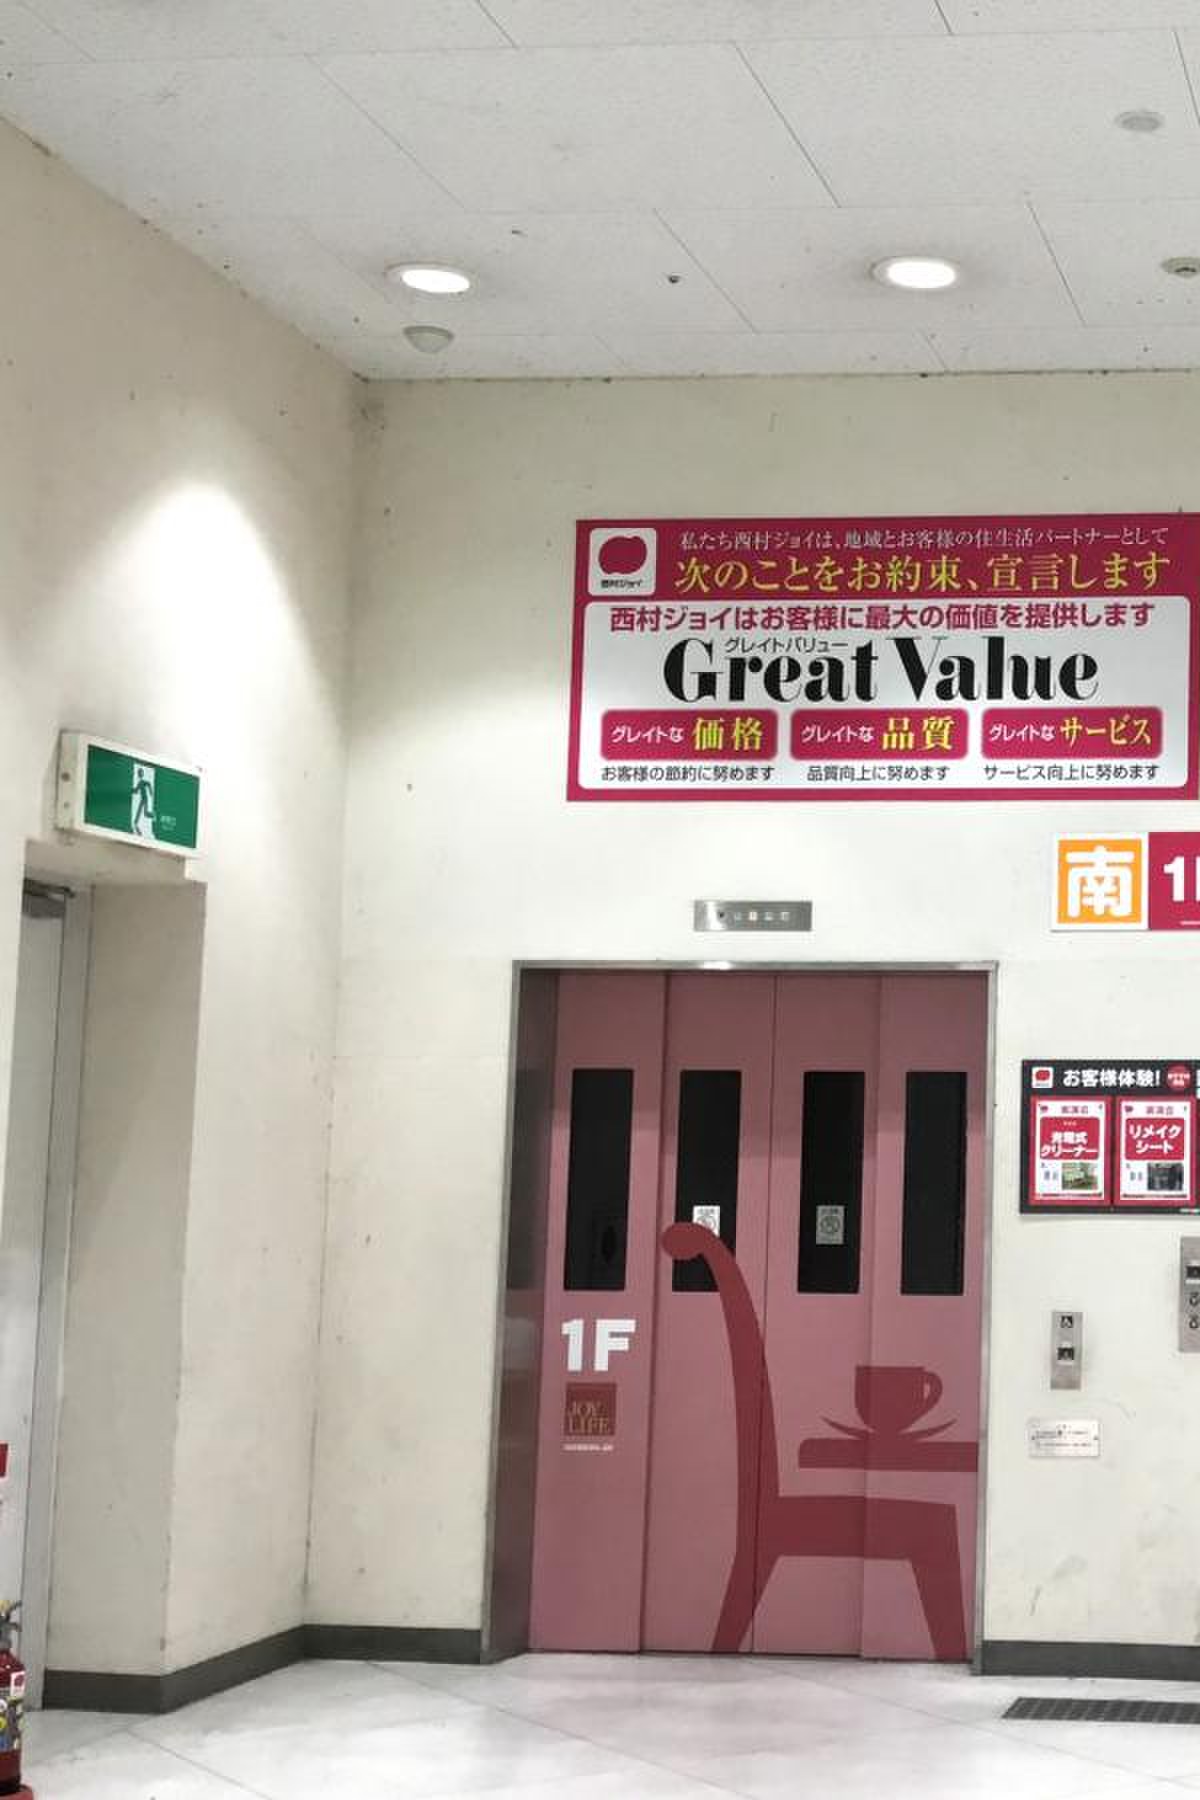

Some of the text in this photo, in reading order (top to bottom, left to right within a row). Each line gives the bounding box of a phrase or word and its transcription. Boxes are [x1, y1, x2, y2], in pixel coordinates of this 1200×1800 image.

[680, 527, 1169, 551] 私たち西村ジョイは、地域とお客様の住生活パートナーとして
[675, 551, 1171, 593] 次のことをお約束、宣言します
[610, 602, 1155, 632] 西村ジョイはお客様に最大の価値を提供します
[724, 637, 849, 654] グレイトバリュー
[663, 635, 1100, 703] Great Value
[610, 717, 763, 751] グレイトな 価格
[801, 716, 955, 751] グレイトな 品質
[989, 714, 1152, 747] グレイトな サービス
[601, 765, 775, 782] お客様の節約に努めます
[807, 765, 951, 781] 品質向上に努めます
[983, 764, 1160, 781] サービス向上に努めます
[1065, 845, 1135, 918] 南
[1128, 1124, 1182, 1140] リメイク
[1040, 1144, 1099, 1158] クリーナー
[1135, 1140, 1174, 1155] シート
[561, 1318, 637, 1372] 1F
